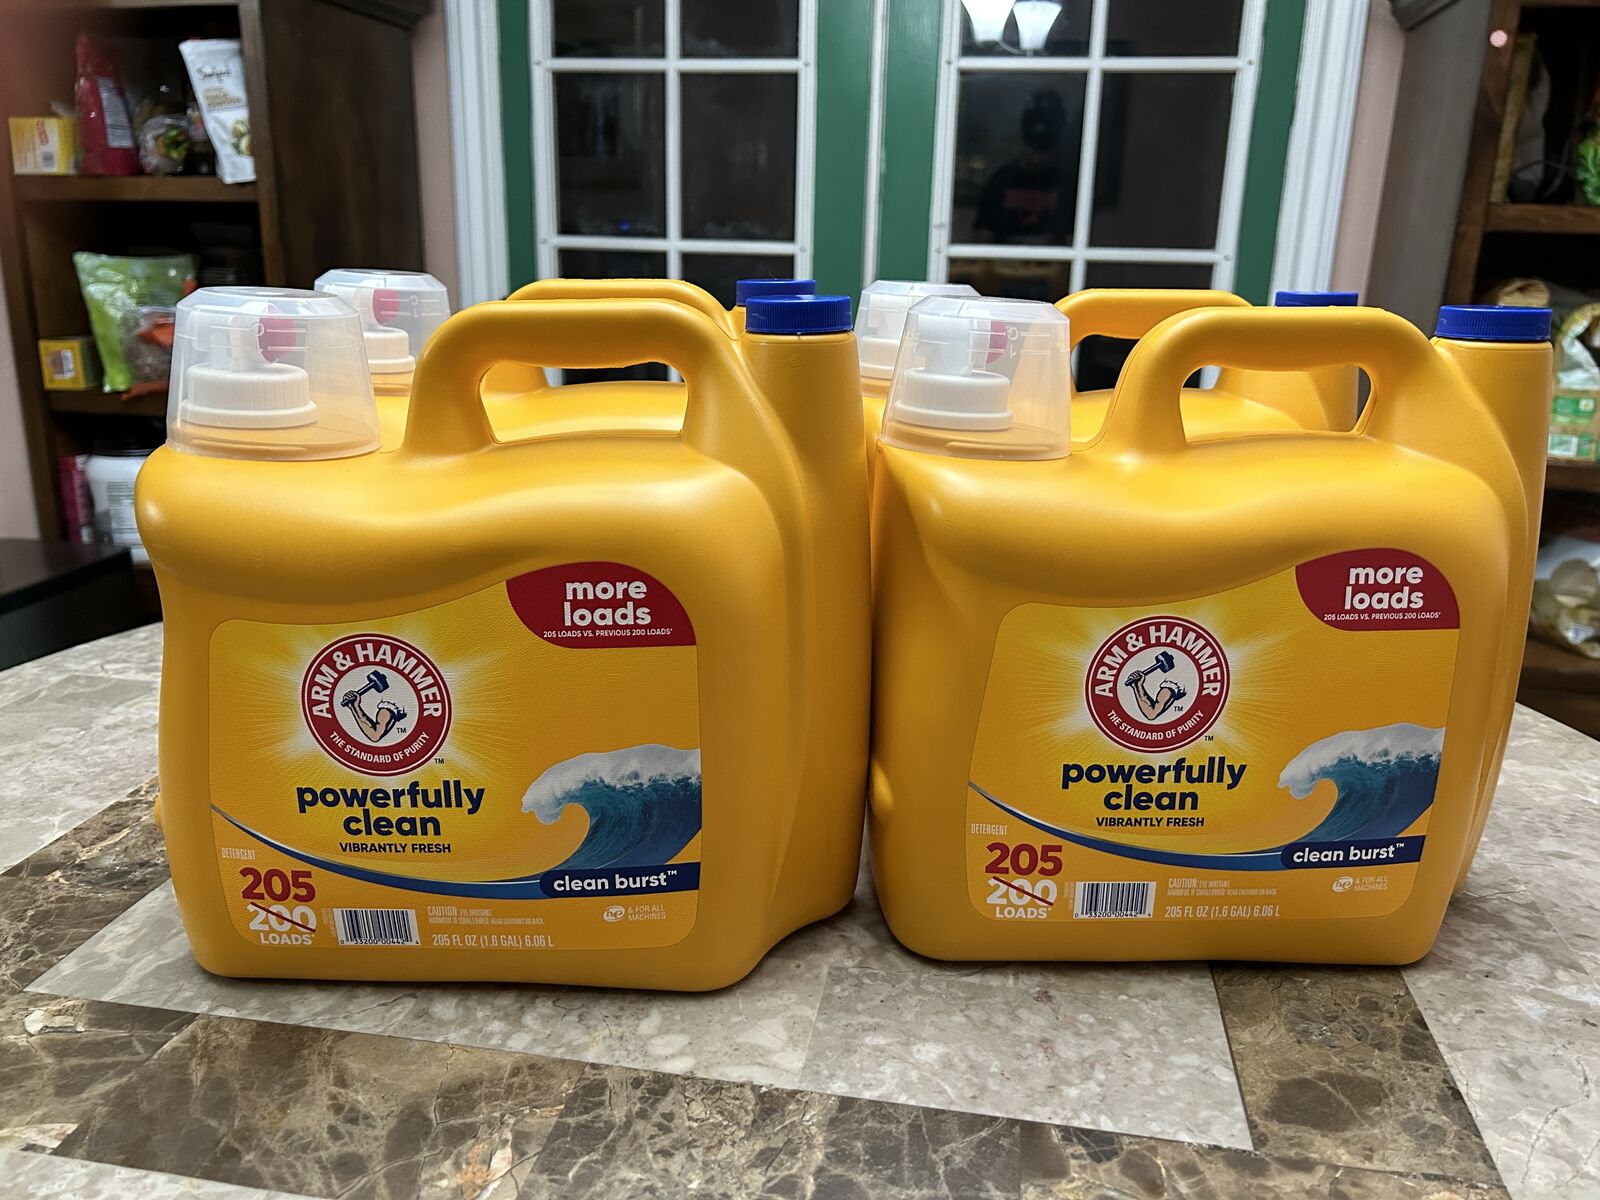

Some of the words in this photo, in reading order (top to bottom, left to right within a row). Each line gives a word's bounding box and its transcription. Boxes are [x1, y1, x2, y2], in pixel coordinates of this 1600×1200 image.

[1350, 566, 1424, 584] more
[566, 580, 647, 600] more
[1344, 586, 1424, 610] loads
[564, 602, 651, 626] loads
[1337, 613, 1359, 621] LOADS
[543, 630, 557, 638] 205
[596, 629, 631, 637] PREVIOUS
[632, 628, 646, 636] 200
[1094, 644, 1128, 698] ARM
[1125, 632, 1146, 652] &
[1148, 624, 1221, 697] HAMMER
[311, 664, 338, 719] ARM
[332, 650, 355, 670] &
[354, 642, 442, 718] HAMMER
[1107, 709, 1122, 726] THE
[1118, 722, 1164, 740] STANDARD
[1166, 728, 1176, 739] OF
[1177, 710, 1204, 735] PURITY
[330, 731, 346, 749] THE
[344, 744, 392, 764] STANDARD
[392, 752, 405, 762] OF
[404, 732, 430, 758] PURITY
[1061, 756, 1247, 790] powerfully
[296, 780, 485, 814] powerfully
[1103, 784, 1199, 810] clean
[342, 808, 441, 836] clean
[971, 823, 1008, 836] DETERGENT
[1096, 817, 1162, 827] VIBRANTLY
[1166, 817, 1205, 827] FRESH
[221, 847, 256, 860] DETERGENT
[339, 842, 407, 854] VIBRANTLY
[411, 843, 451, 854] FRESH
[985, 842, 1063, 876] 205
[1293, 848, 1344, 863] clean
[239, 867, 316, 902] 205
[553, 874, 609, 891] clean
[986, 878, 1057, 906] 200
[246, 904, 317, 932] 200
[628, 912, 666, 921] MACHINES
[635, 905, 650, 913] FOR
[652, 904, 664, 912] ALL
[1165, 906, 1182, 918] 205
[1184, 906, 1193, 918] FL
[1196, 906, 1209, 917] OZ
[1211, 906, 1228, 918] (1.6
[1231, 906, 1251, 918] GAL)
[1253, 905, 1273, 917] 6.06
[1275, 905, 1280, 916] L
[432, 934, 450, 946] 205
[452, 934, 463, 946] FL
[465, 934, 478, 946] OZ
[480, 934, 498, 948] (1.6
[501, 935, 522, 948] GAL)
[524, 935, 545, 947] 6.06
[548, 935, 554, 947] L
